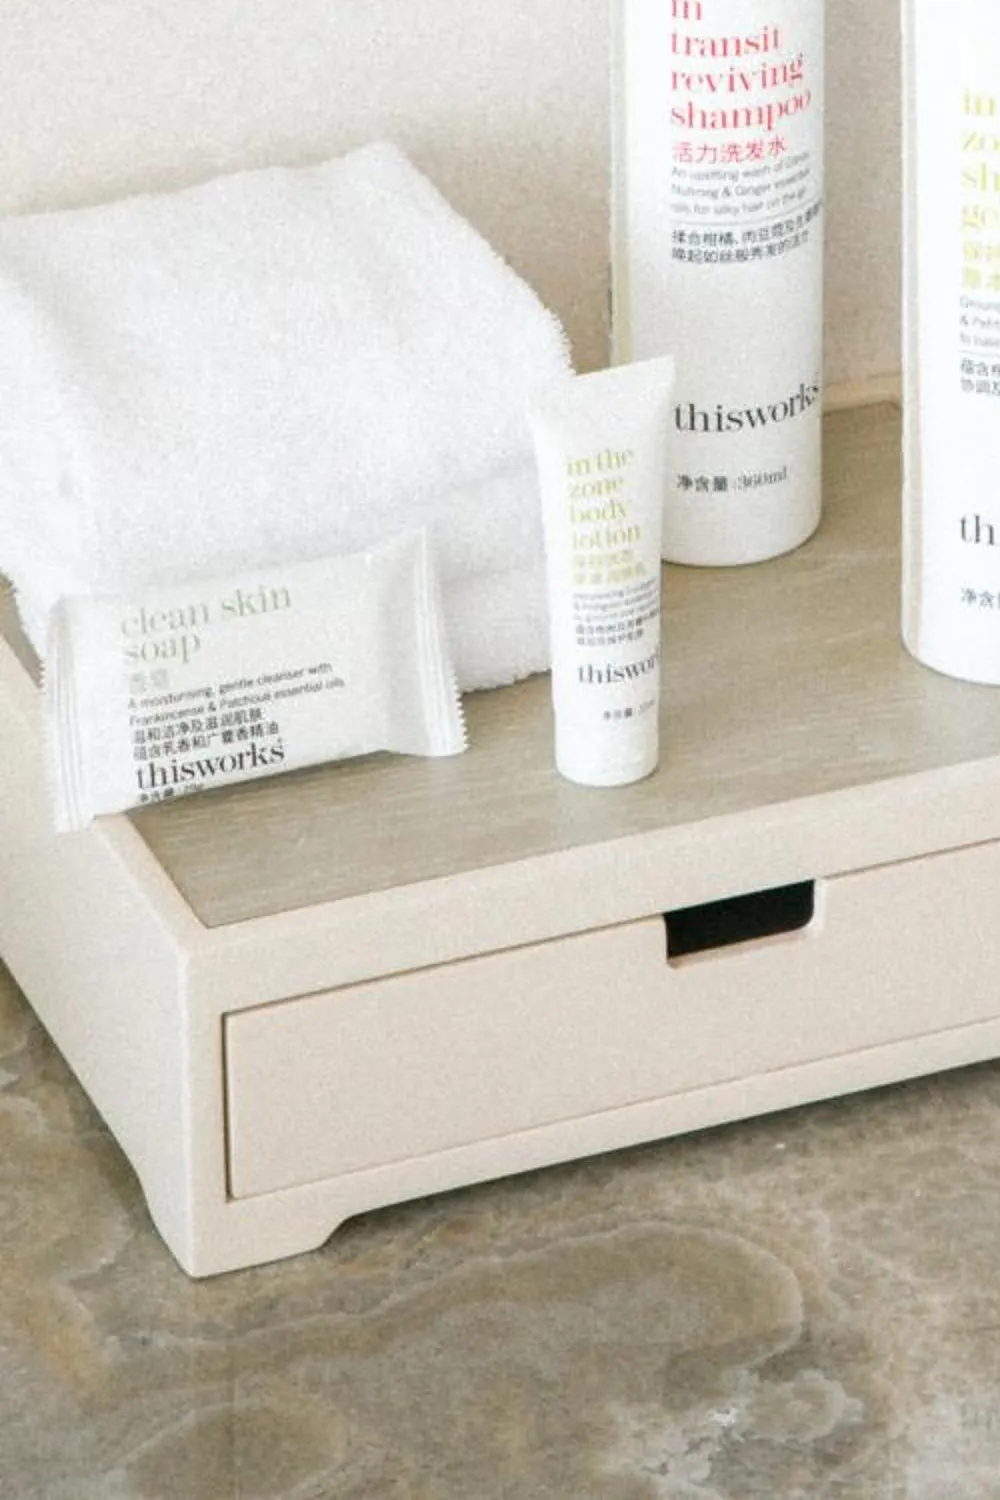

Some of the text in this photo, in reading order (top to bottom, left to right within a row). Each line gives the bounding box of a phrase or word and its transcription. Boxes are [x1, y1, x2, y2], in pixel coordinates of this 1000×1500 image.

[670, 25, 779, 57] transit
[671, 53, 803, 92] reviving
[670, 88, 811, 132] shampoo
[964, 88, 995, 117] in
[672, 136, 787, 164] 活力洗发水
[569, 476, 624, 498] zone
[570, 499, 630, 523] body
[573, 523, 640, 550] lotion
[121, 585, 292, 637] clean skin
[124, 634, 201, 665] soap
[207, 701, 217, 712] &
[137, 742, 285, 789] thisworks
